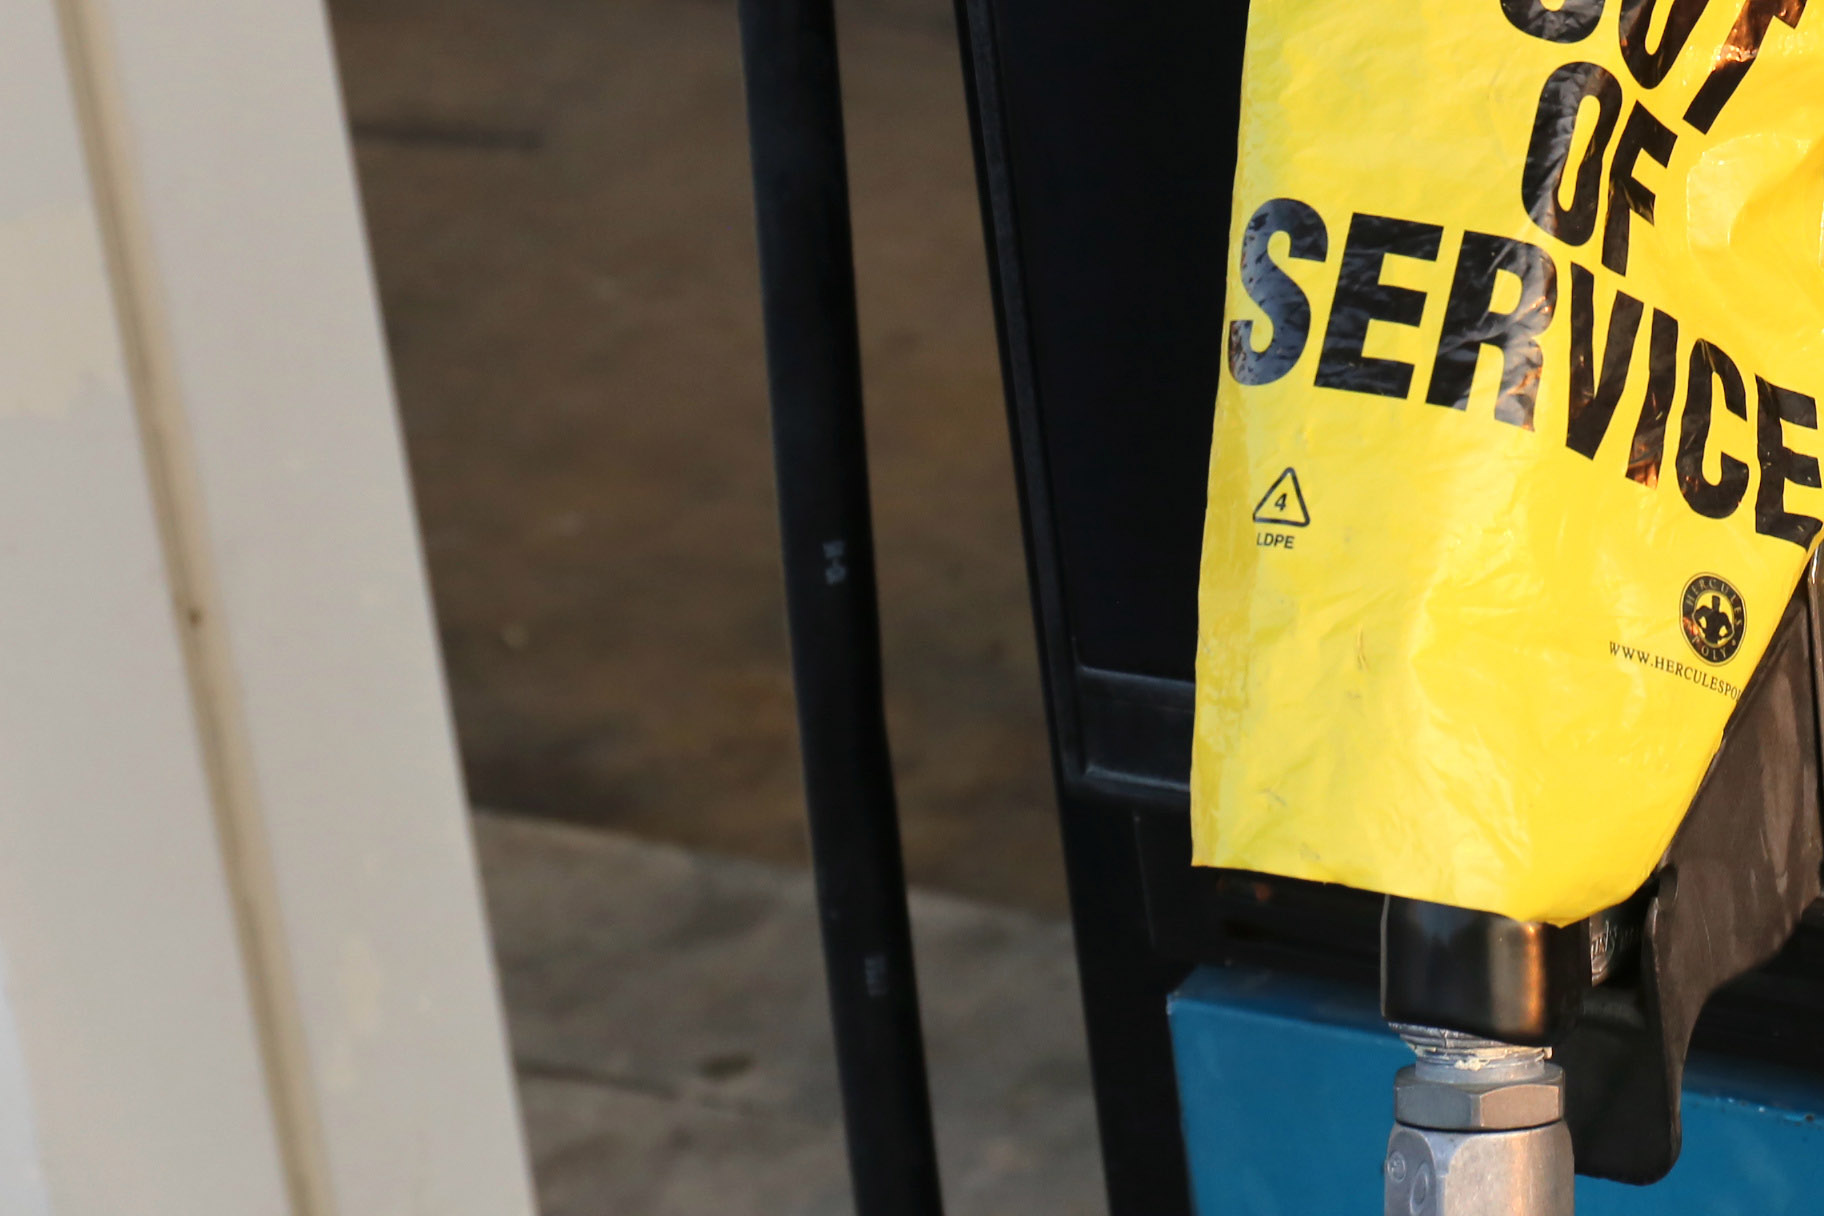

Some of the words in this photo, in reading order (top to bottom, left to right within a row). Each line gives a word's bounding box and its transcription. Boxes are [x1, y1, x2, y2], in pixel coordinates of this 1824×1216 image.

[1521, 60, 1678, 278] OF
[1256, 532, 1295, 549] LDPE
[1685, 578, 1743, 627] HERCULES
